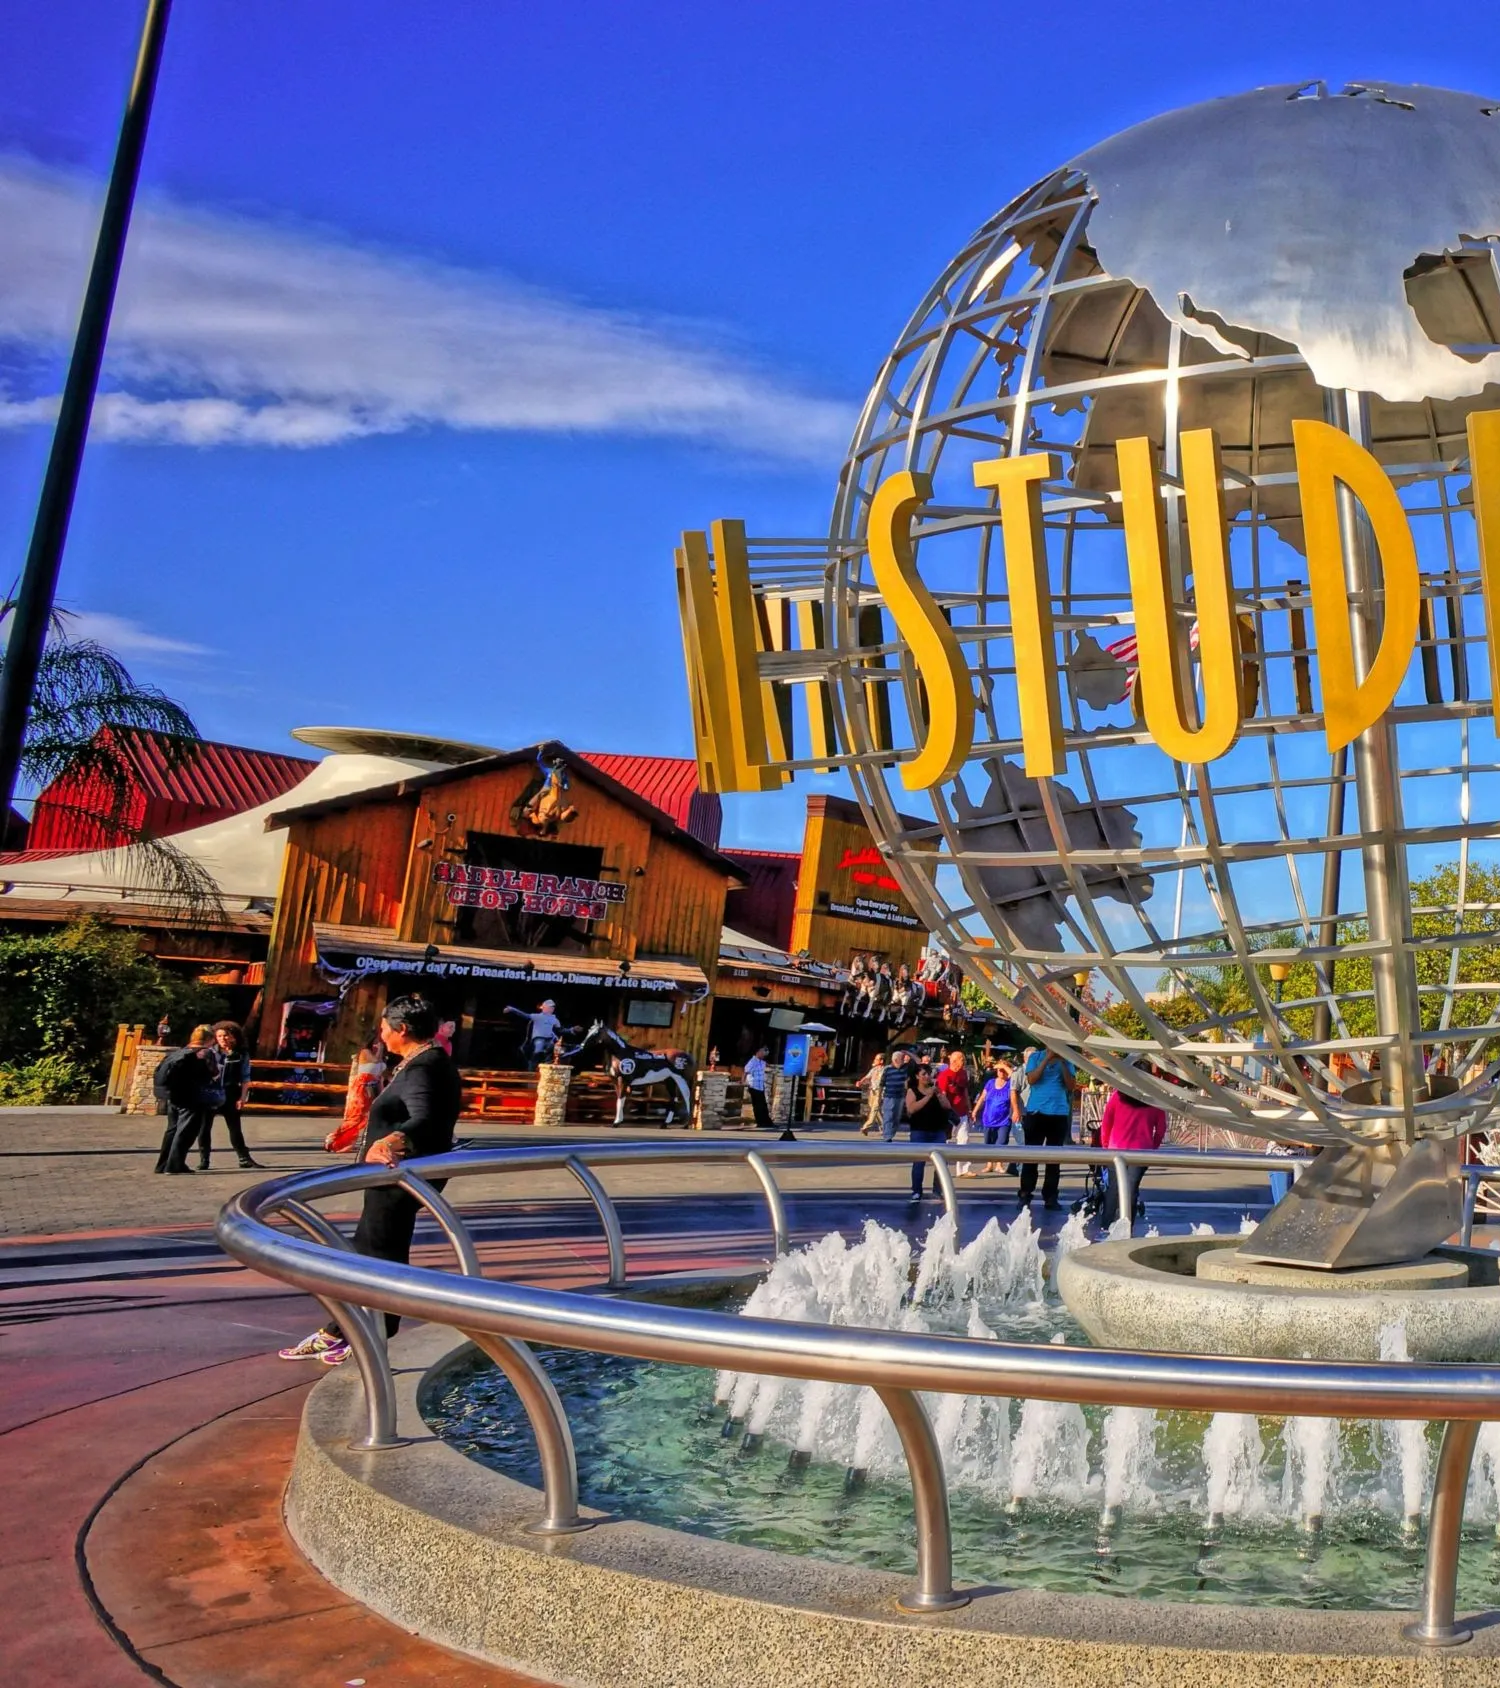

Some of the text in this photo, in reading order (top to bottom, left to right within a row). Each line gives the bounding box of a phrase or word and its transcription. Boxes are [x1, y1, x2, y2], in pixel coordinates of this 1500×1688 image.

[433, 861, 626, 903] SADDLE RANCH
[447, 885, 607, 920] CHOP HOUSE
